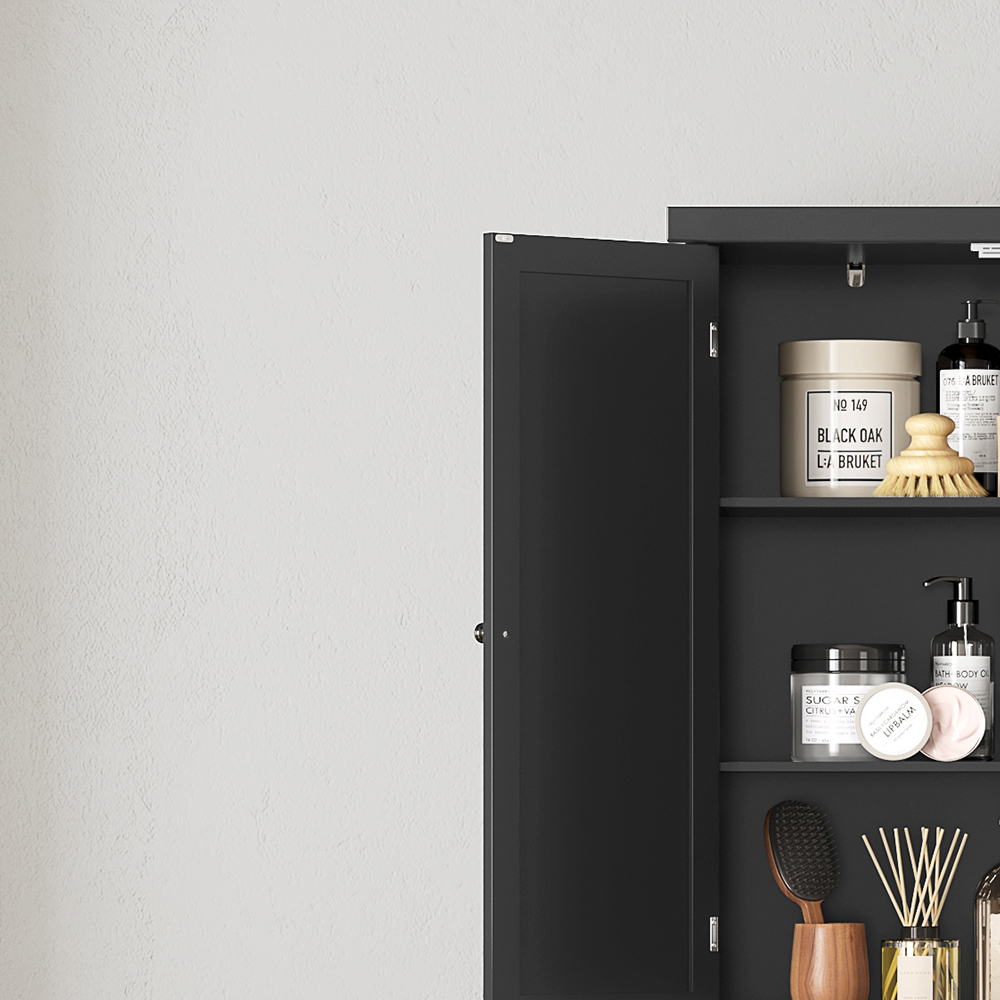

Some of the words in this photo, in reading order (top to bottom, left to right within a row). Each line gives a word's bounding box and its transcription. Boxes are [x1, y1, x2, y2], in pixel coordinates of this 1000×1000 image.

[972, 374, 999, 386] BRUKET
[851, 398, 868, 412] 149
[817, 427, 857, 443] BLACK
[859, 427, 883, 443] OAK
[838, 454, 883, 469] BRUKET
[805, 695, 849, 705] SUGAR
[853, 695, 861, 705] S
[805, 706, 856, 716] CITRUS+VA
